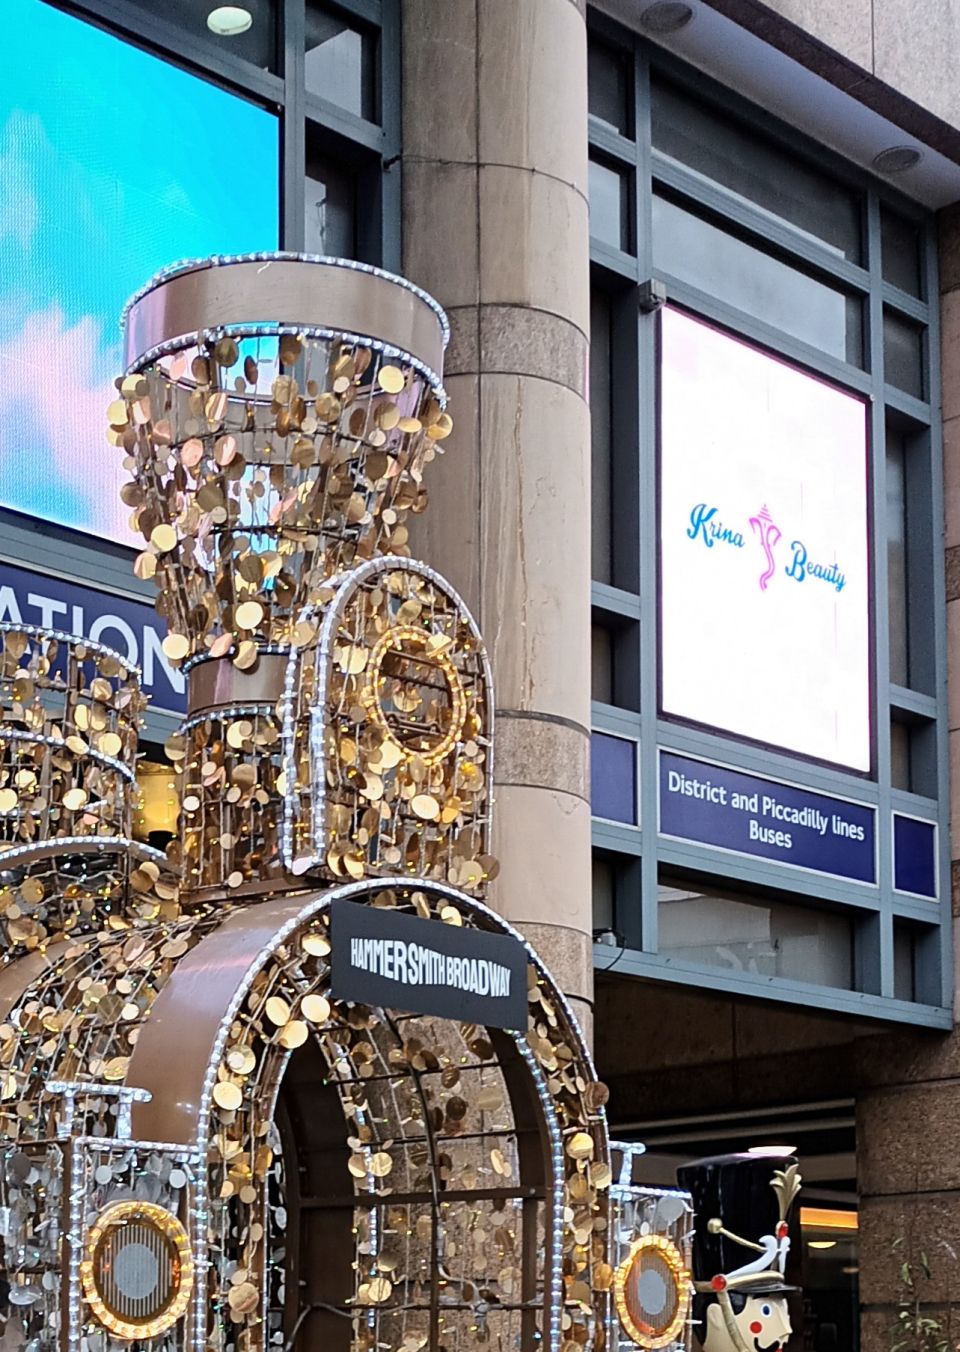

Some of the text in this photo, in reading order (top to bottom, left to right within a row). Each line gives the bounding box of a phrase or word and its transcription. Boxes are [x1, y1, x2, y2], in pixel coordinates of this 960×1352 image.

[686, 503, 846, 592] Krina Beauty
[668, 770, 865, 842] District and Piccadilly lines
[749, 820, 793, 848] Buses
[350, 938, 511, 997] HAMMERSMITH BROADWAY
